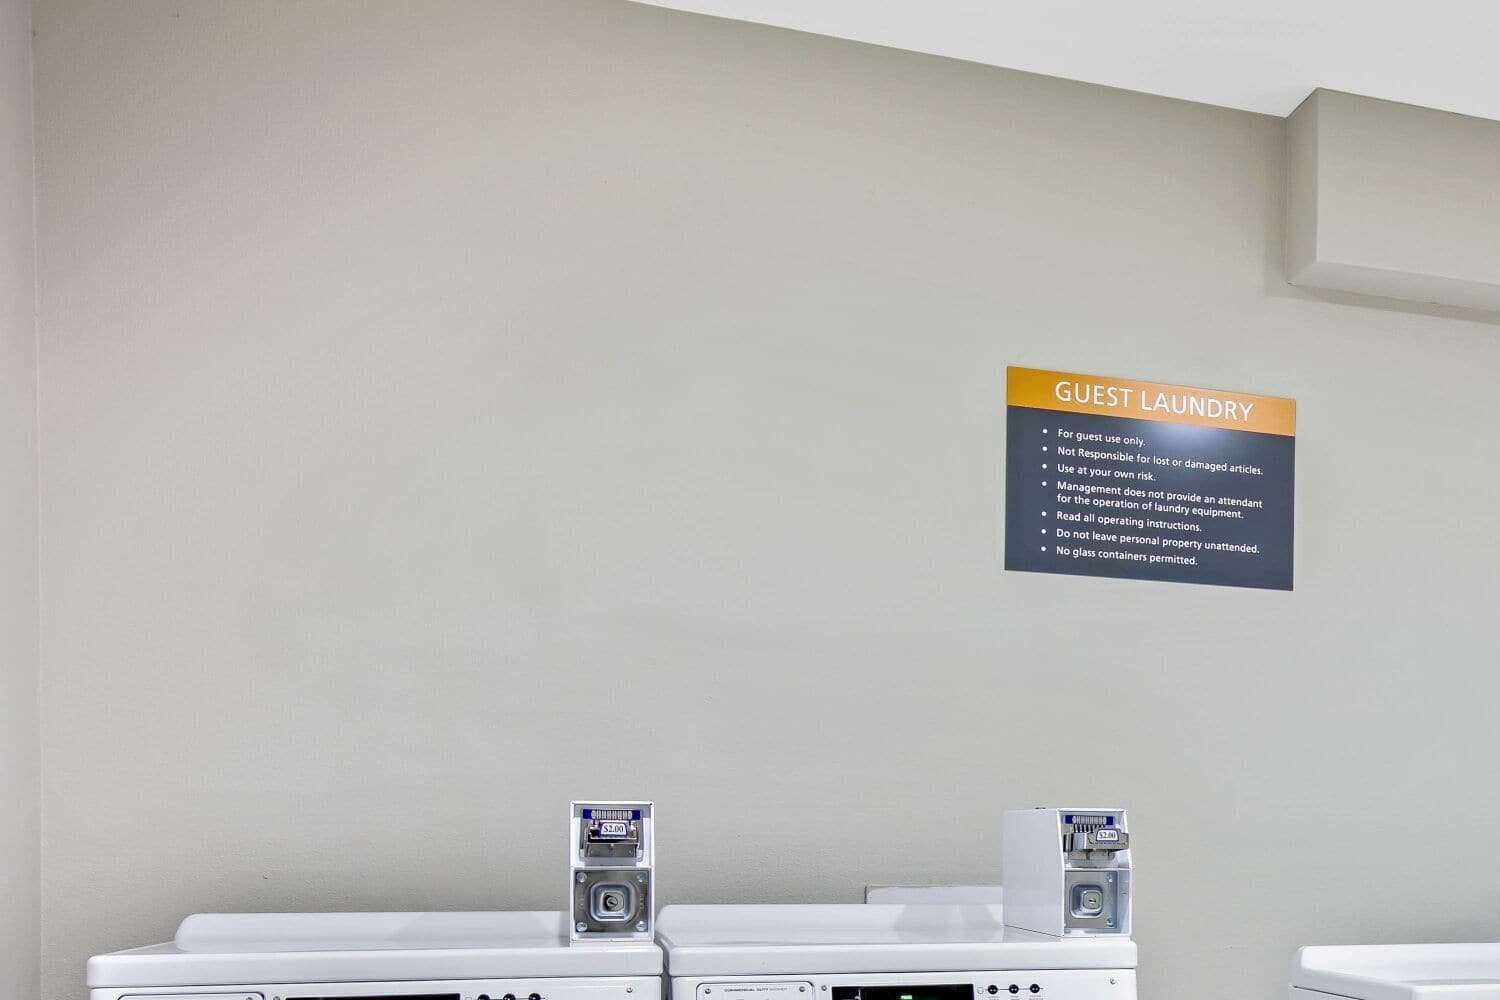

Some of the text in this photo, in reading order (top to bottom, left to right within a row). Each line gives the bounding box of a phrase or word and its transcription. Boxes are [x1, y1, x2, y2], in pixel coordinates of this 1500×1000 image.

[1055, 381, 1254, 422] GUEST LAUNDRY
[1057, 428, 1146, 448] For guest use only.
[1057, 446, 1264, 475] Not Responsible for lost or damaged articles.
[1057, 463, 1156, 481] Use at your own risk.
[1056, 493, 1245, 519] for the operation of laundry equipment.
[1057, 480, 1263, 509] Management does not provide an attendant
[1056, 511, 1202, 532] Read all operating instructions.
[1056, 528, 1260, 554] Do not leave personal property unattended.
[1056, 545, 1198, 566] No glass containers permitted.
